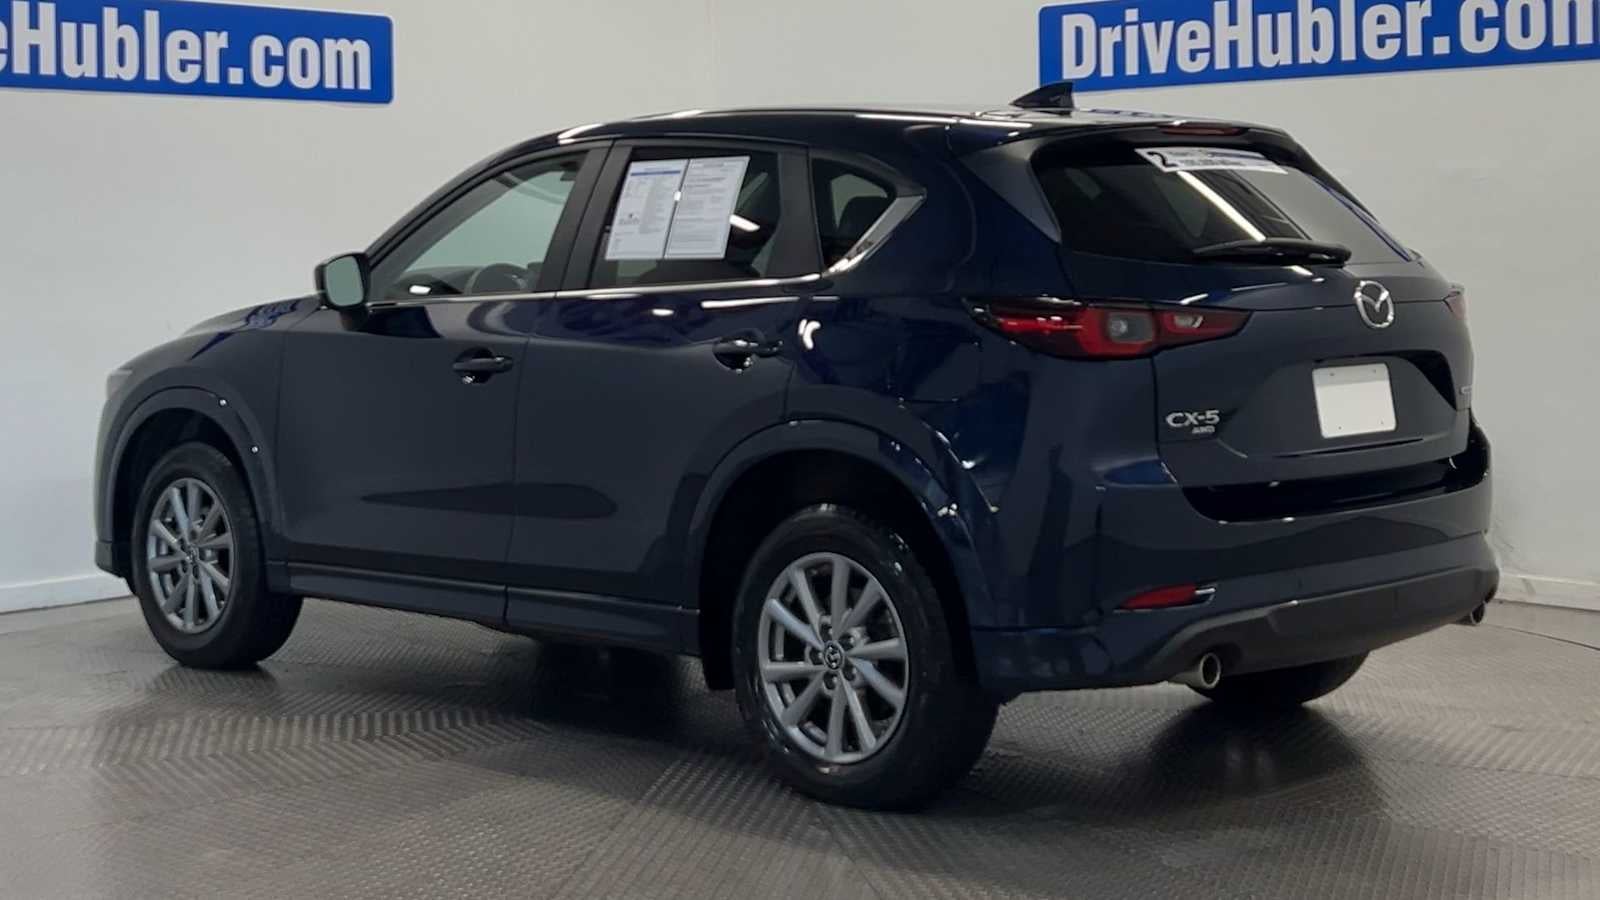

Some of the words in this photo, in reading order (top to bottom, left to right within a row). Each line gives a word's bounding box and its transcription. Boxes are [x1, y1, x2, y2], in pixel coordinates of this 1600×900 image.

[0, 0, 372, 90] Hubler.com
[1147, 151, 1178, 167] 2
[1165, 409, 1220, 427] CX-5
